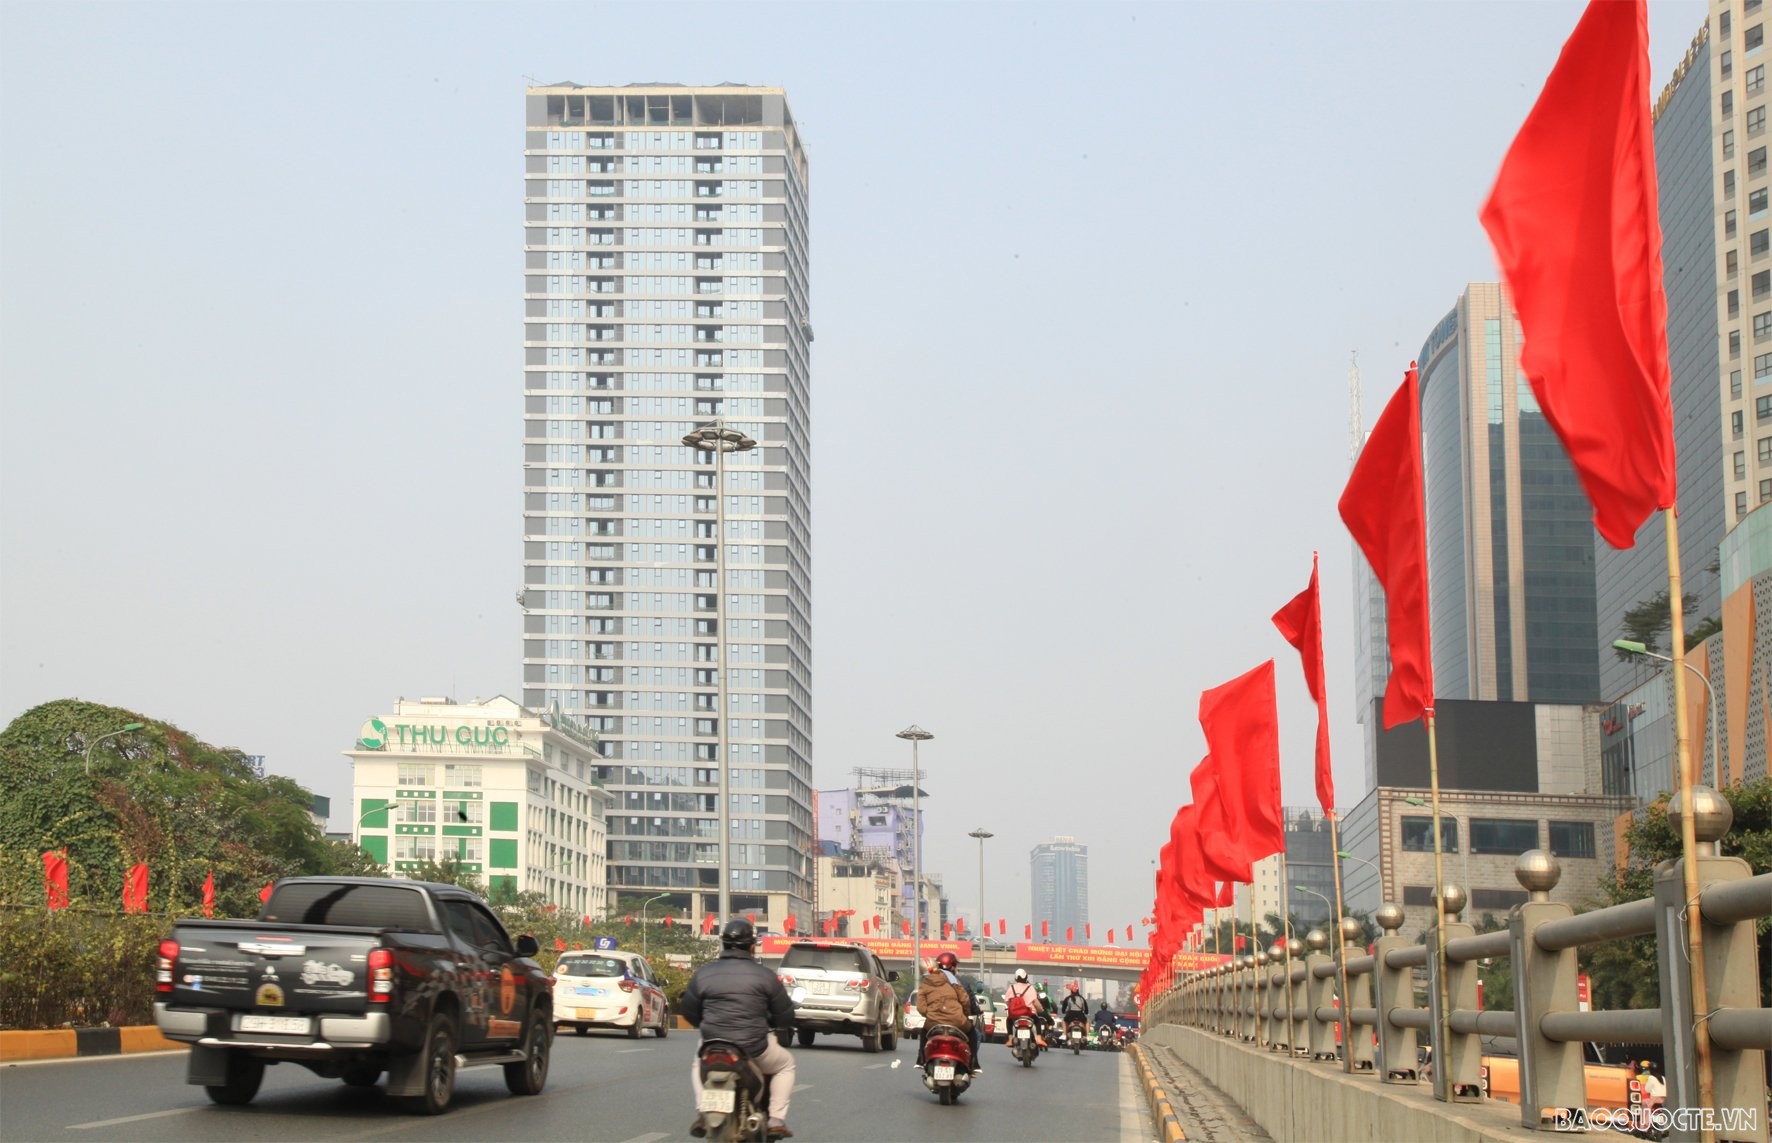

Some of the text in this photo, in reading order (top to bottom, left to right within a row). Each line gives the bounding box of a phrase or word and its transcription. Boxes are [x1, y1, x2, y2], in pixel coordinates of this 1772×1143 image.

[395, 723, 446, 744] THU
[1028, 945, 1049, 953] NHIỆT
[1068, 947, 1089, 955] CHÀO
[1090, 948, 1113, 956] MỪNG
[1129, 950, 1142, 958] HỘI
[1097, 955, 1118, 963] ĐẢNG
[1119, 957, 1141, 965] CỘNG
